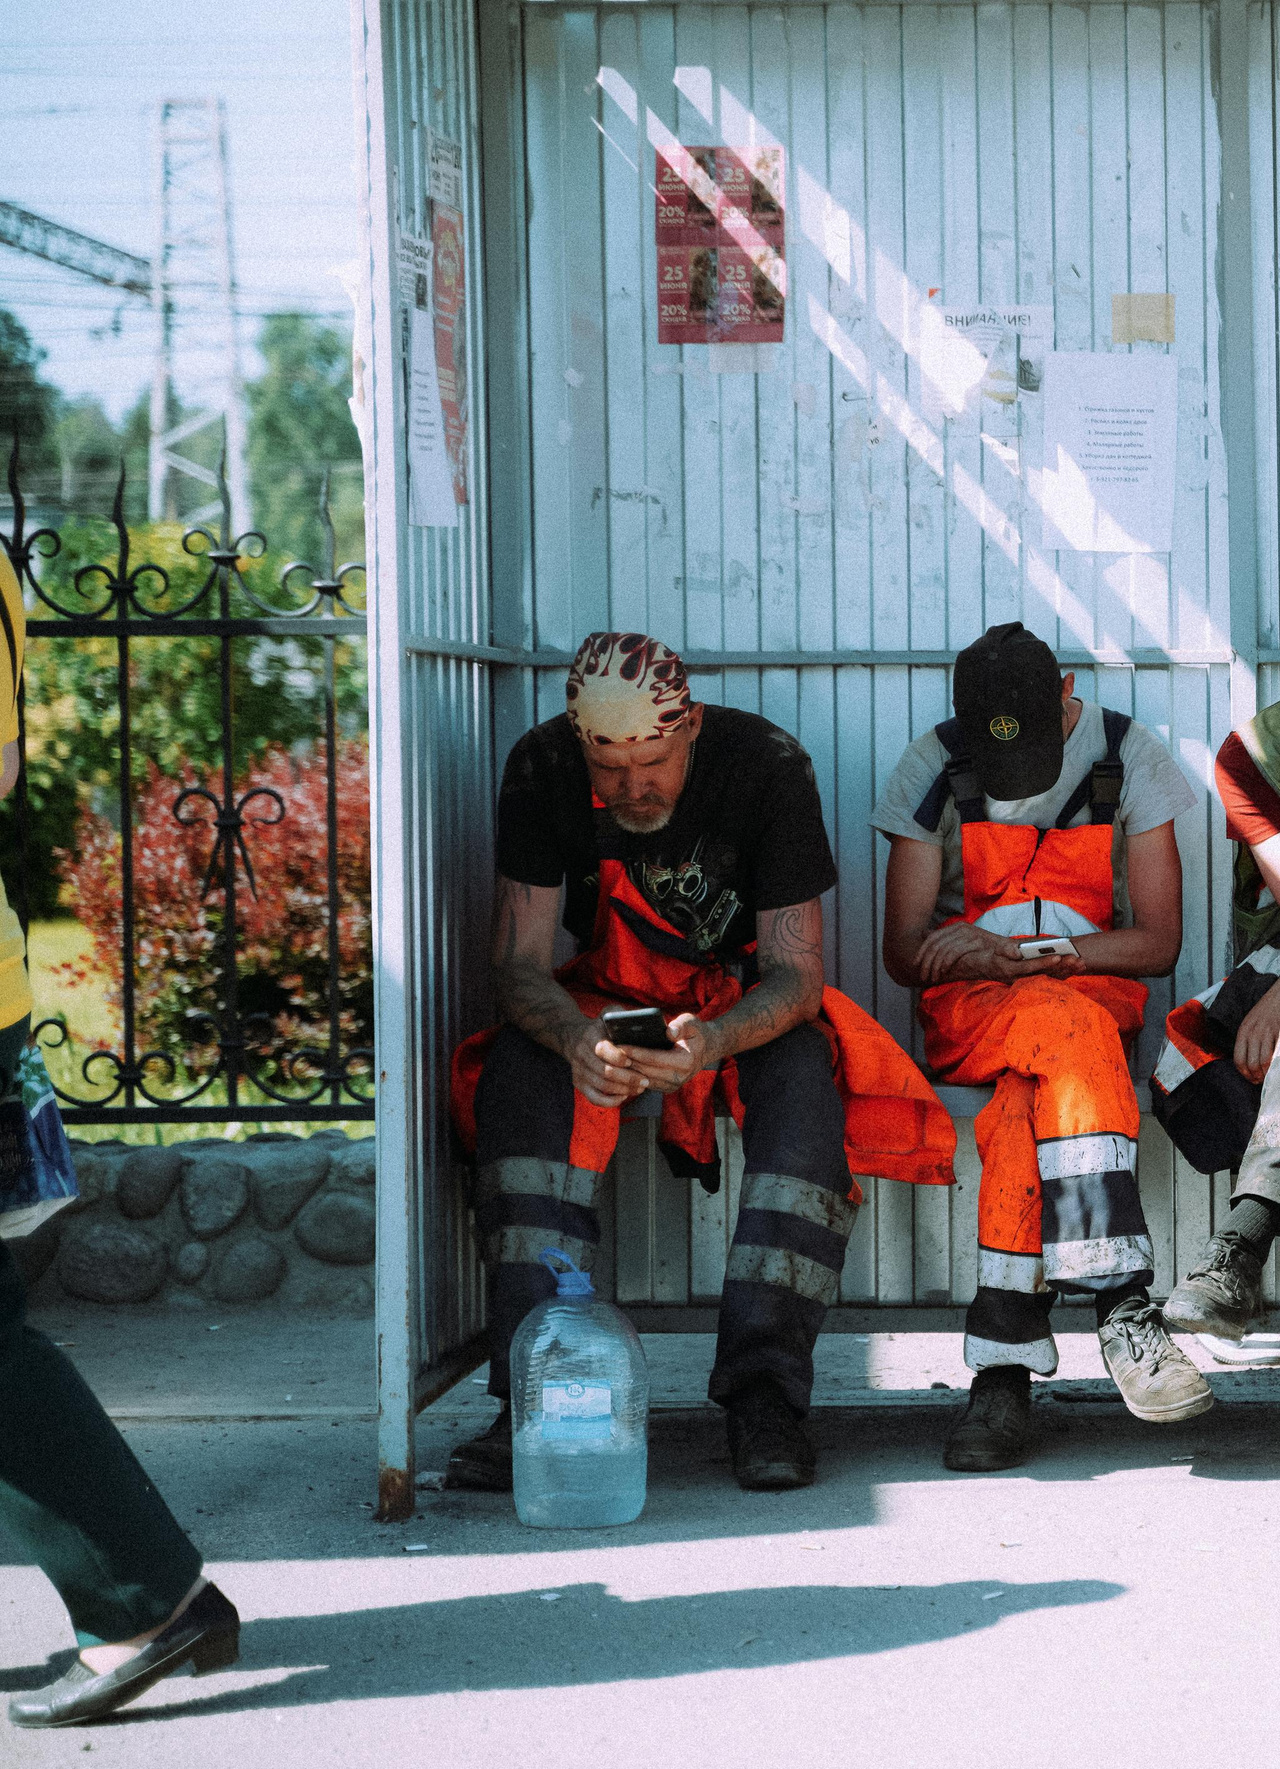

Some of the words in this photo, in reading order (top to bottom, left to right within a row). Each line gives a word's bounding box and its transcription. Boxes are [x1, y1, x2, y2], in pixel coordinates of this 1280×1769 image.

[722, 167, 746, 183] 25
[659, 205, 686, 217] 20%
[663, 265, 684, 281] 25
[725, 265, 747, 281] 25
[661, 304, 688, 316] 20%
[722, 304, 751, 316] 20%
